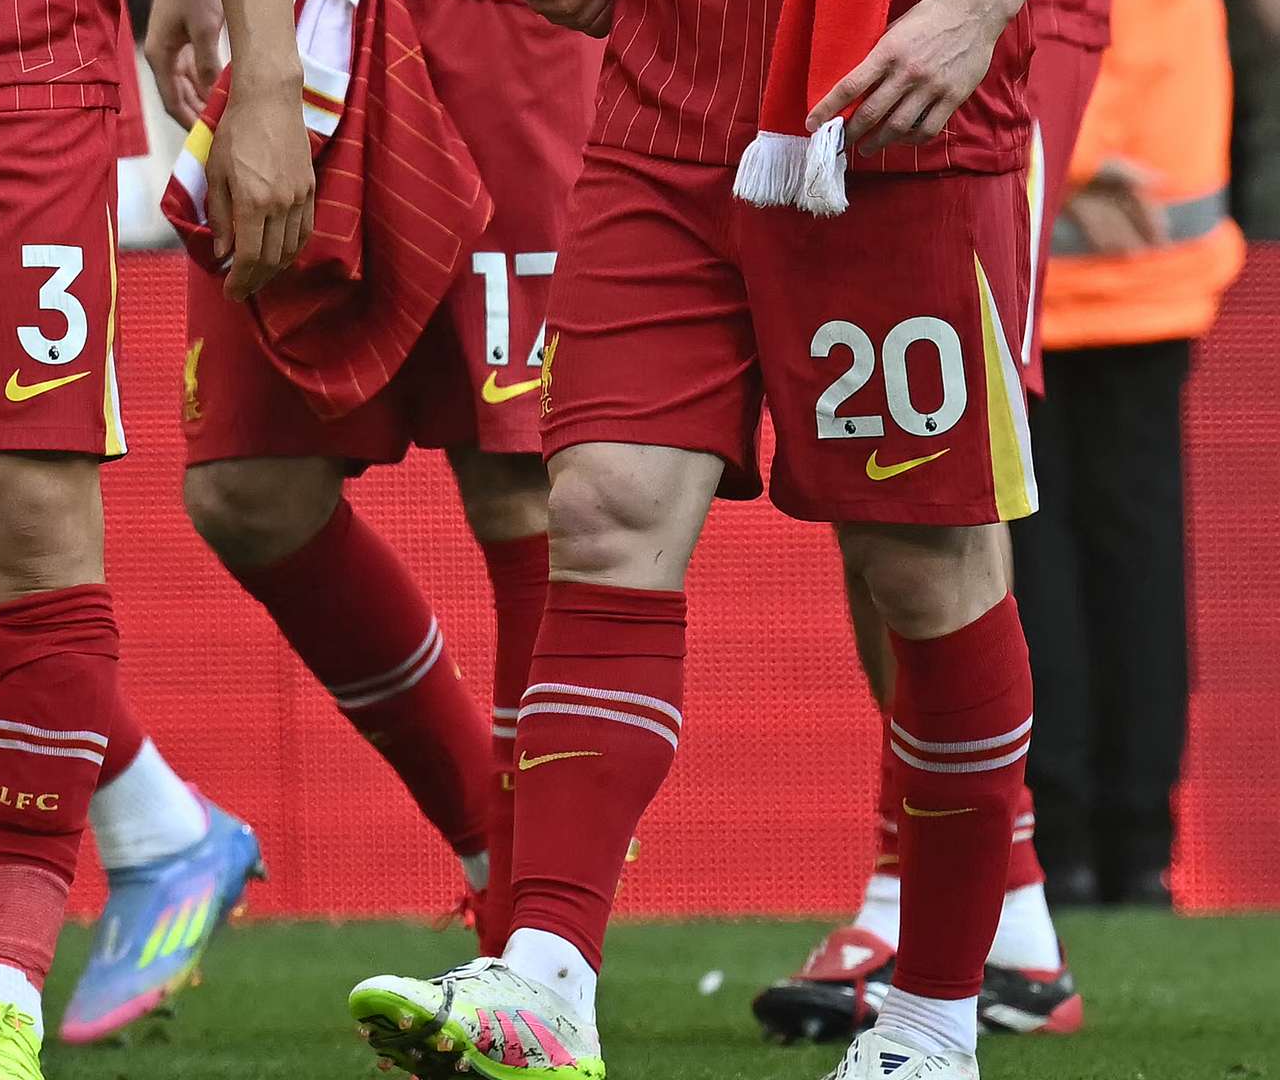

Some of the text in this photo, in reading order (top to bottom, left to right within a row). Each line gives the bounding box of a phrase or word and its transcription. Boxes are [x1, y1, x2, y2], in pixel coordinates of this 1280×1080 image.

[16, 243, 89, 365] 3
[810, 316, 968, 440] 20
[0, 785, 60, 811] LFC
